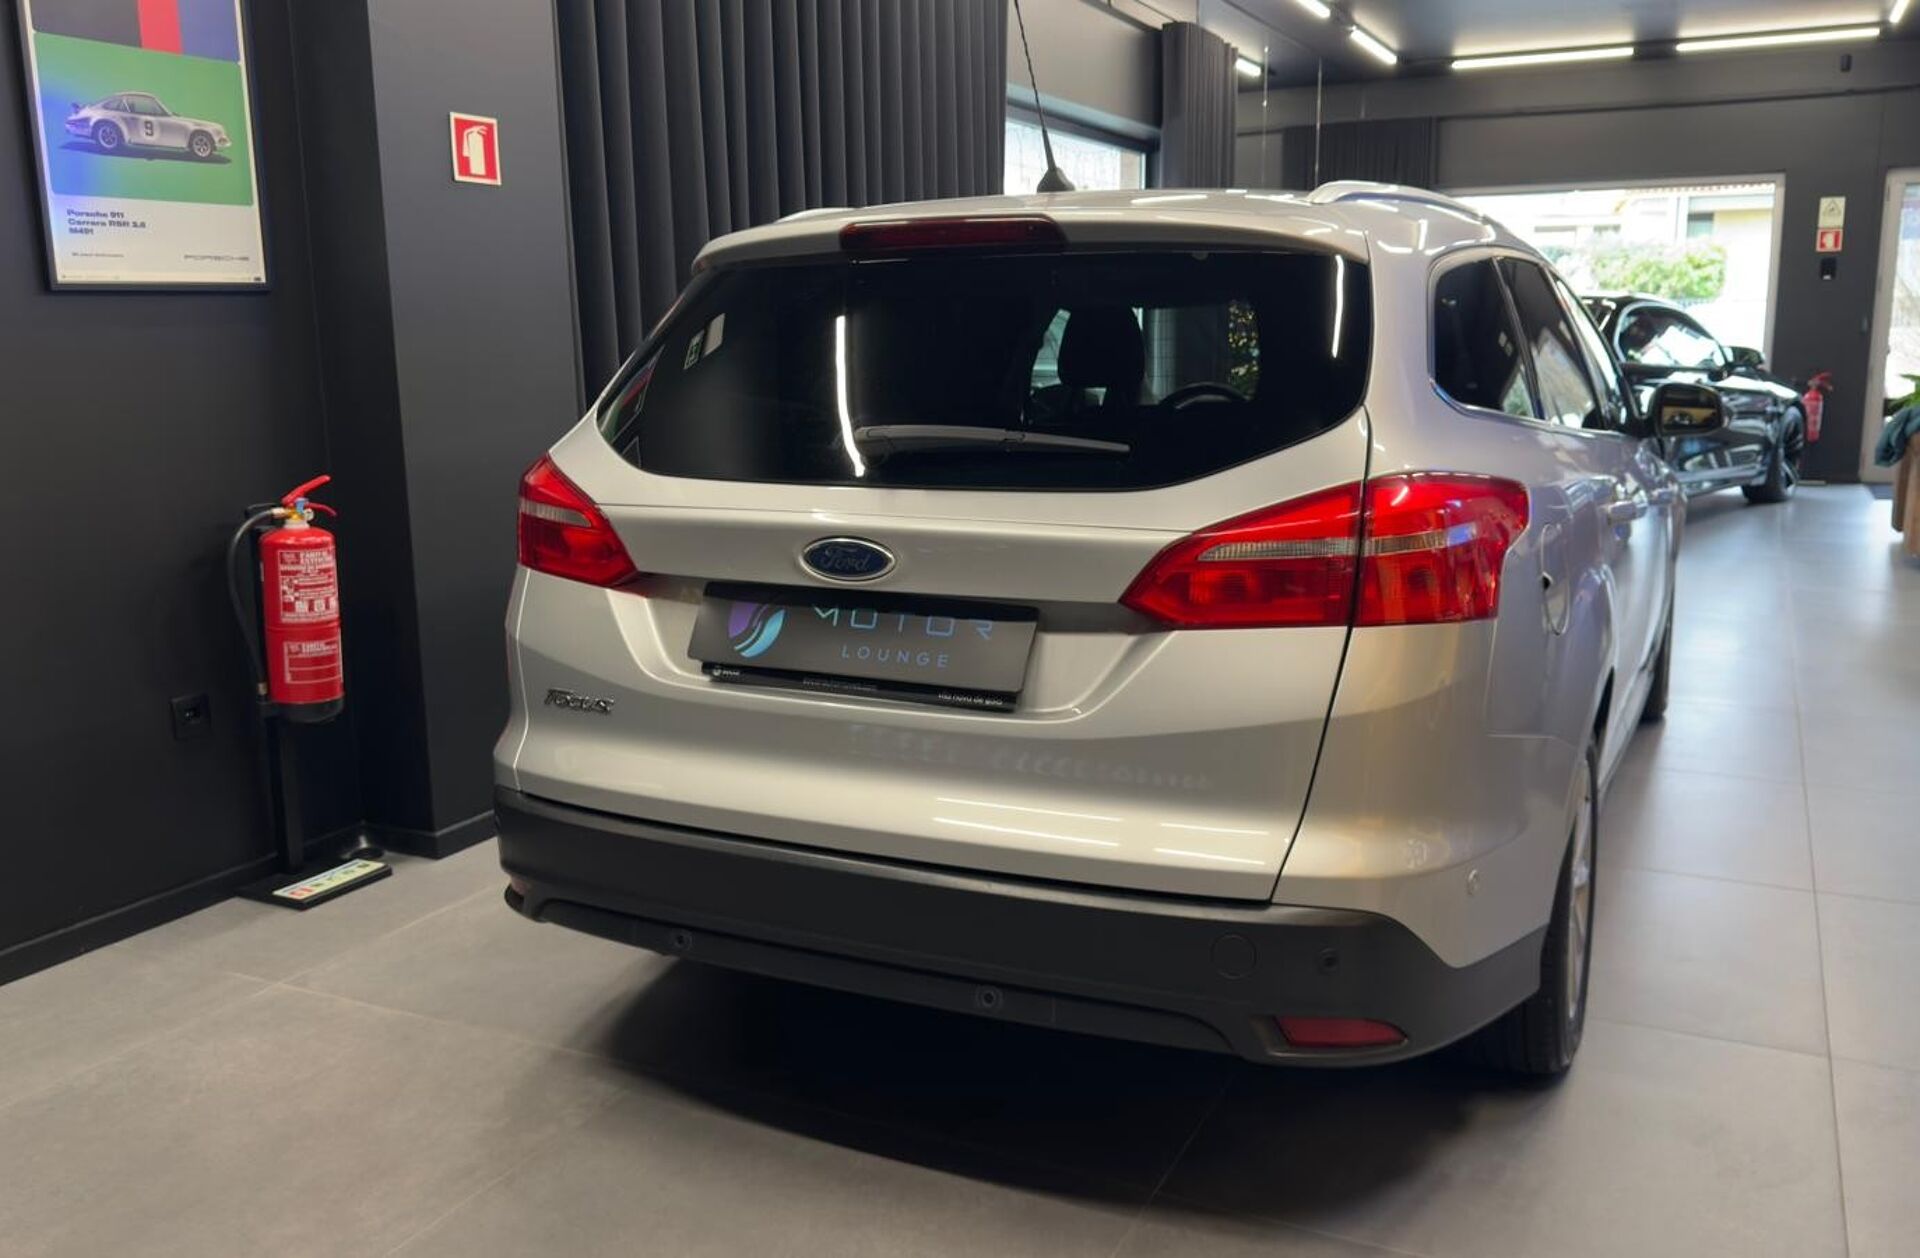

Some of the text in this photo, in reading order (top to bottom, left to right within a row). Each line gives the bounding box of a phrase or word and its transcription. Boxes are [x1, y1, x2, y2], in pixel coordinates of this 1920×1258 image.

[144, 120, 154, 137] 9
[67, 209, 125, 219] Porsche 911
[68, 218, 107, 227] Carrera
[184, 254, 250, 262] PORSCHE
[821, 545, 873, 571] Ford
[842, 645, 950, 669] LOUNGE
